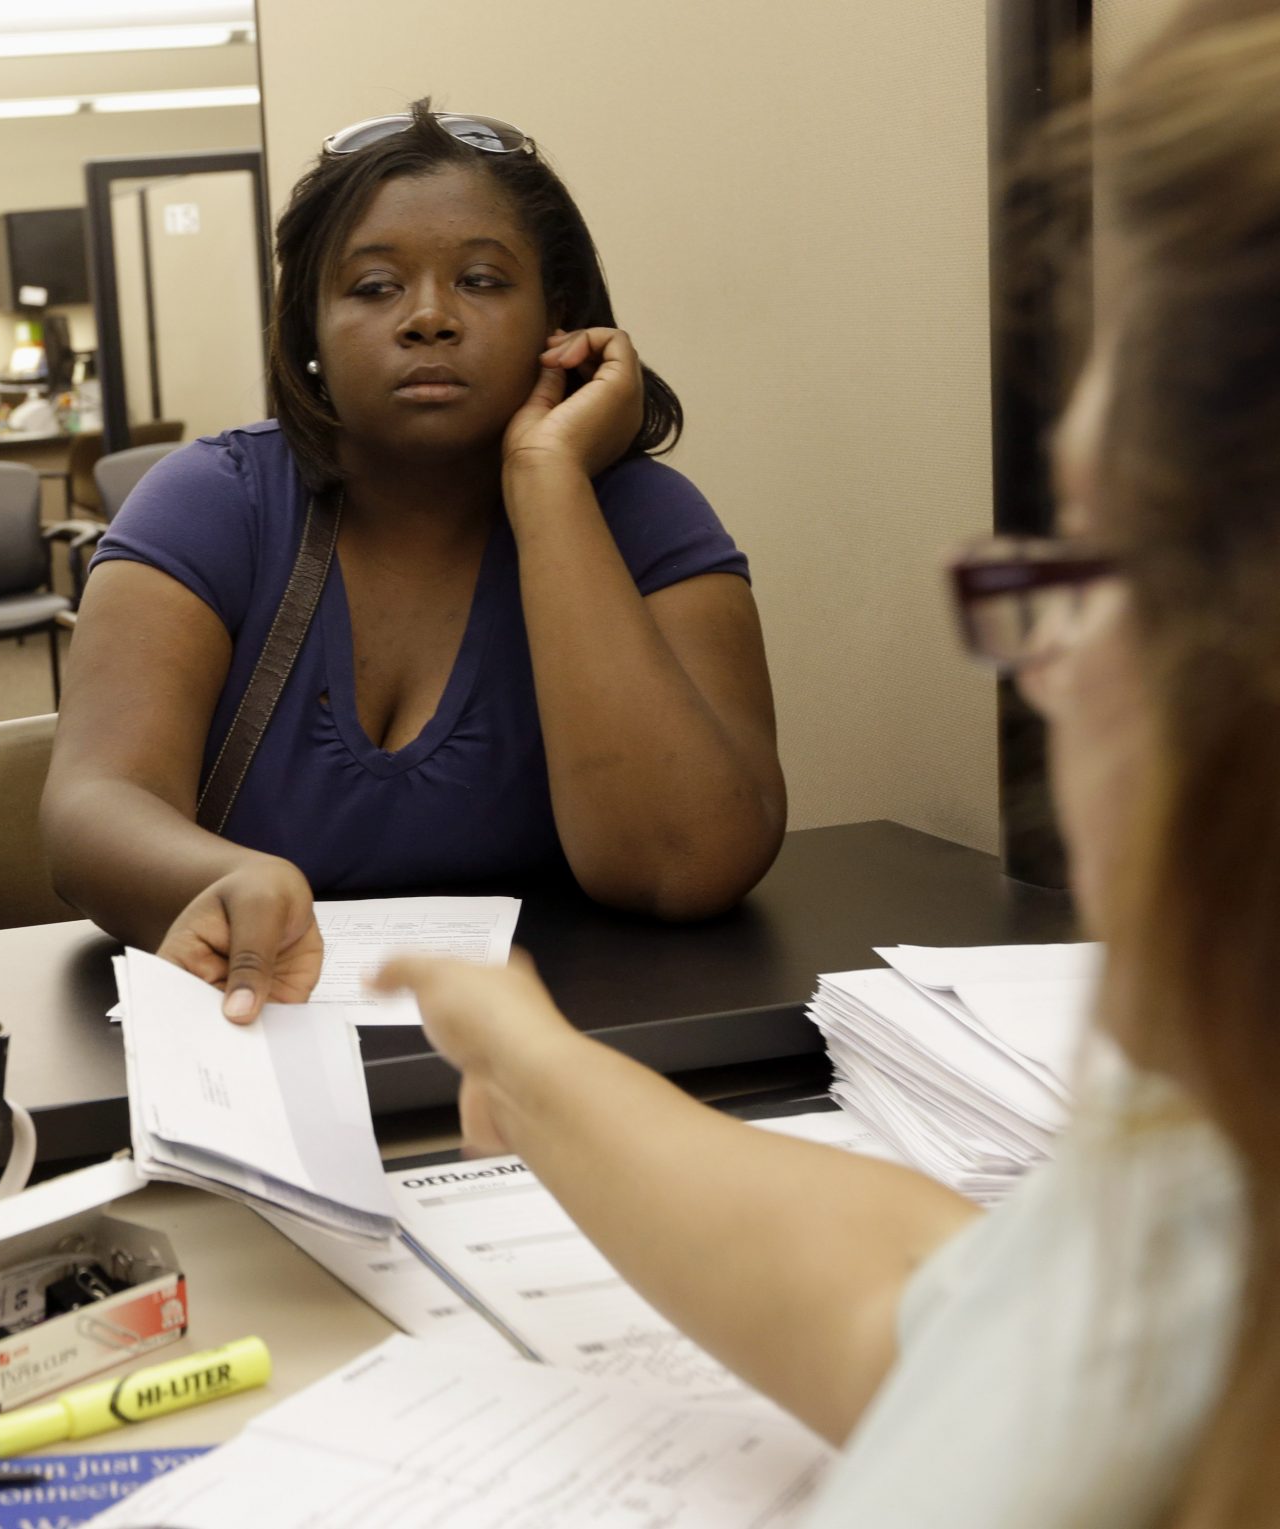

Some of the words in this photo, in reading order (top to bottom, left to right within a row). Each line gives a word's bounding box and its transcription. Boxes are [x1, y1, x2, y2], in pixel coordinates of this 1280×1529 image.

[402, 1163, 528, 1188] OfficeM
[137, 1363, 231, 1409] HI-LITER
[74, 1455, 139, 1481] just
